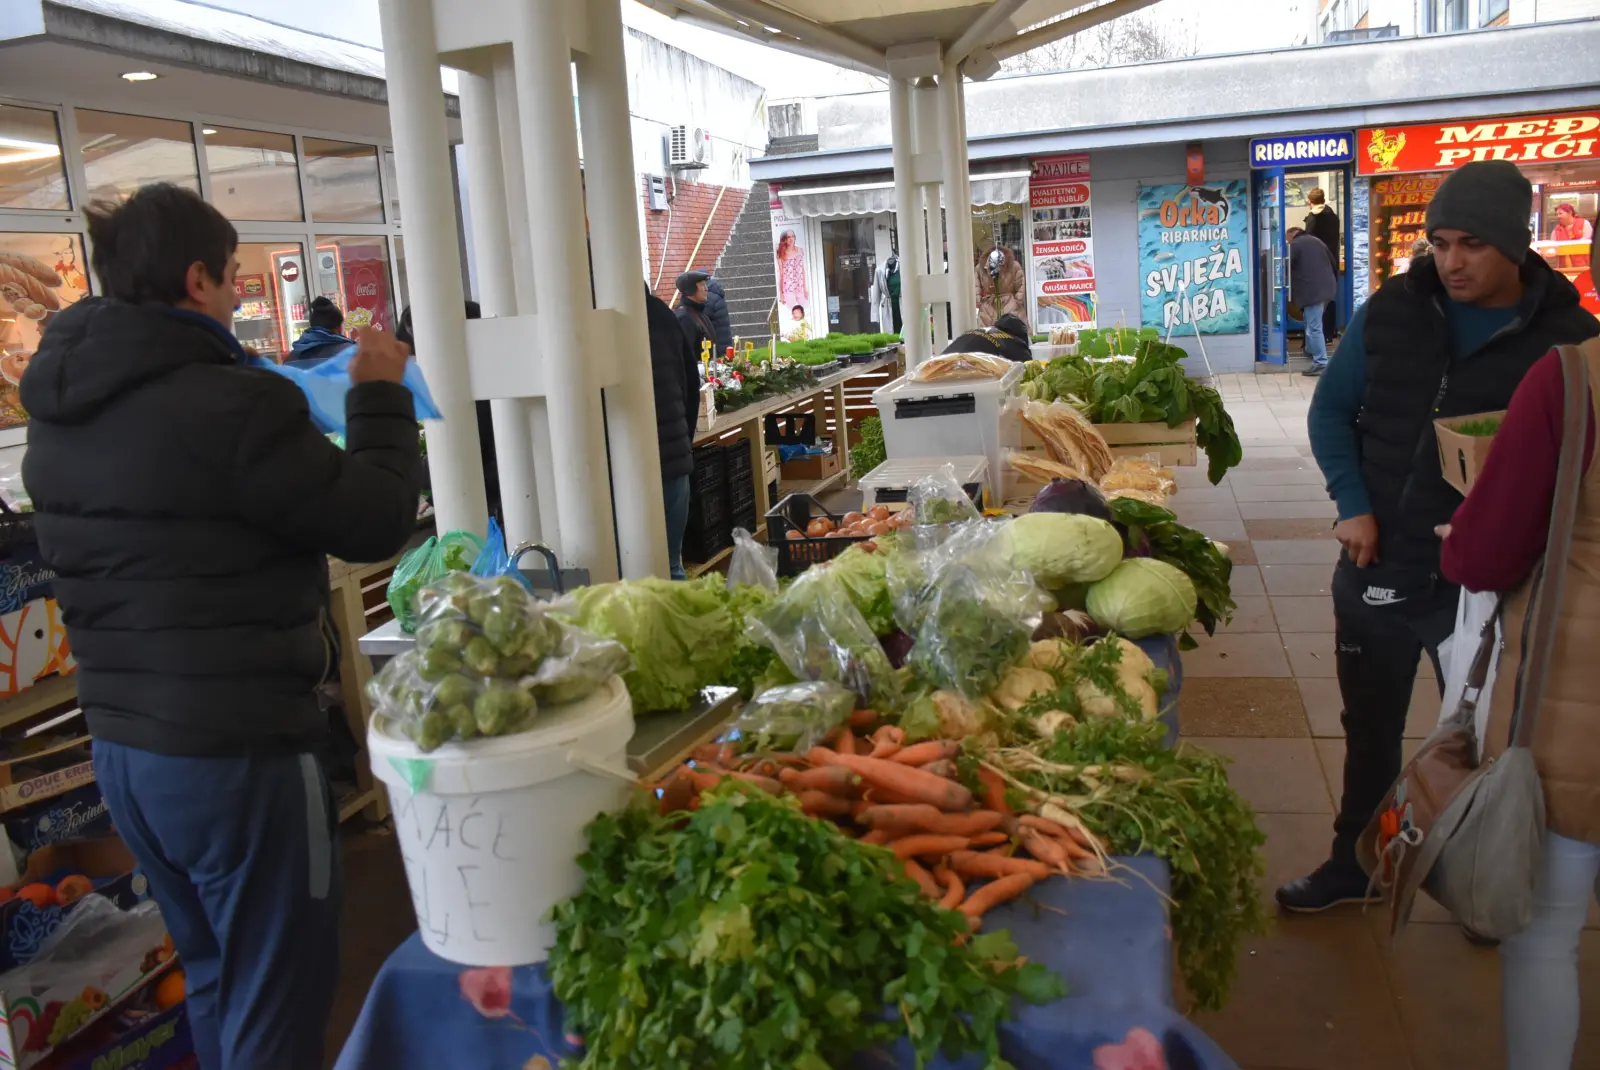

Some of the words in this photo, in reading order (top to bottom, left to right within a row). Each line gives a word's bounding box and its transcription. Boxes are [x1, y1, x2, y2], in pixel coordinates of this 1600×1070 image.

[1434, 117, 1600, 145] MEĐ
[1255, 138, 1349, 161] RIBARNICA
[1434, 135, 1598, 166] PILIĆI
[1042, 161, 1083, 176] MAJICE
[1033, 187, 1077, 197] KVALITETNO
[1375, 180, 1435, 194] SVJE
[1033, 197, 1057, 205] DONJE
[1058, 194, 1085, 203] RUBLJE
[1383, 191, 1434, 205] MES
[1159, 197, 1219, 228] Orka
[1161, 228, 1229, 244] RIBARNICA
[1036, 246, 1060, 254] ŽENSKA
[1061, 244, 1085, 252] ODJEĆA
[1146, 244, 1243, 297] SVJEŽA
[1044, 283, 1068, 292] MUŠKE
[1069, 282, 1093, 290] MAJICE
[1163, 289, 1228, 329] RIBA
[1366, 585, 1396, 601] NIKE
[34, 771, 61, 788] DUE
